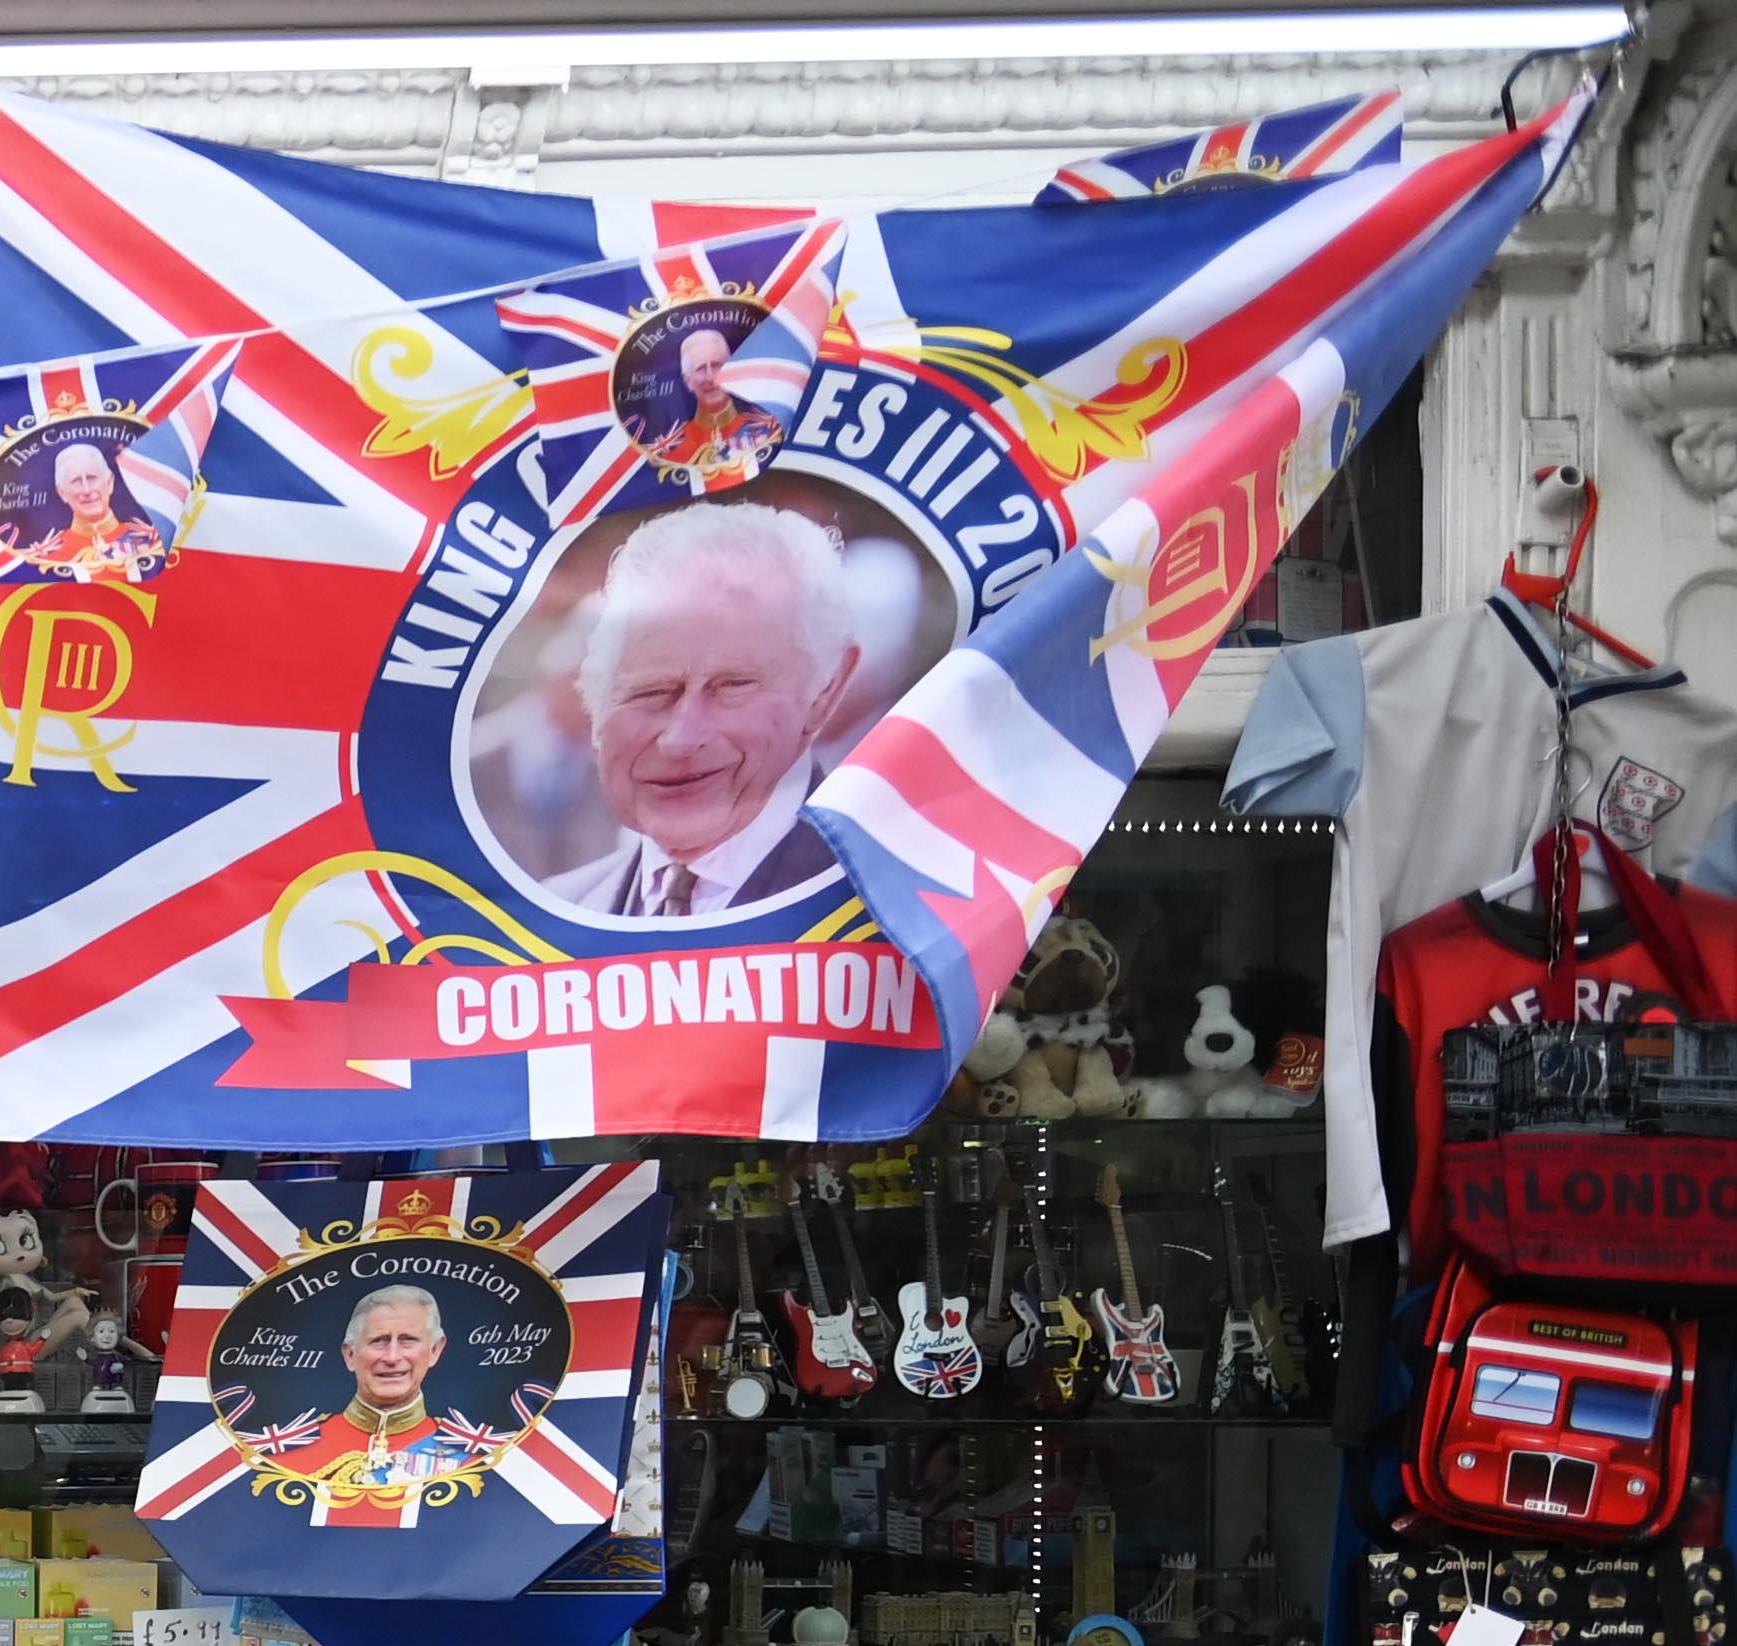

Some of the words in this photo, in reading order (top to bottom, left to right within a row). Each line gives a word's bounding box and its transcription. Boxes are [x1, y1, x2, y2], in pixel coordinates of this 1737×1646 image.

[632, 325, 667, 356] The
[4, 443, 41, 468] The
[894, 403, 1000, 515] III
[2, 481, 31, 496] King
[381, 505, 532, 692] KING
[434, 950, 916, 1047] CORONATION
[276, 1266, 341, 1307] The
[348, 1250, 522, 1307] Coronation
[248, 1326, 299, 1351] King
[467, 1325, 502, 1347] 6th
[505, 1322, 553, 1351] May
[1533, 1323, 1558, 1336] BEST
[1562, 1326, 1576, 1337] OF
[1580, 1328, 1624, 1346] BRITISH
[218, 1343, 293, 1370] Charles
[294, 1348, 324, 1371] III
[483, 1344, 533, 1368] 2023
